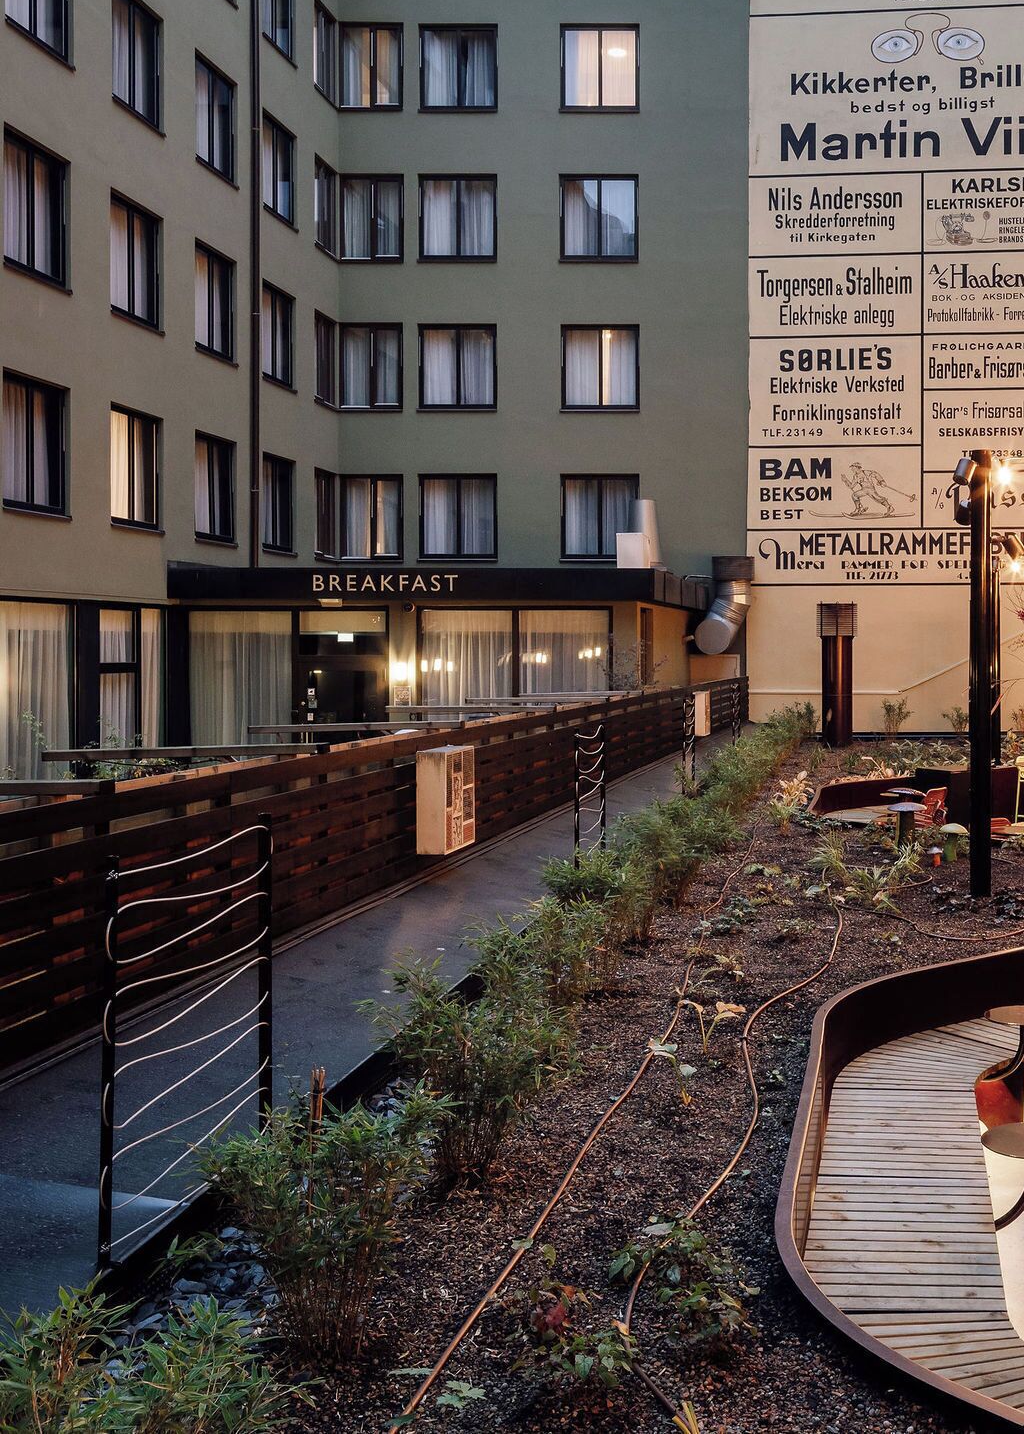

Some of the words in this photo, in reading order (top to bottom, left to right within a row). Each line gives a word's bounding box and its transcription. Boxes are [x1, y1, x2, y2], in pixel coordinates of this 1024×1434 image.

[791, 69, 936, 95] Kikkerter,
[851, 100, 905, 113] bedst
[913, 103, 930, 115] og
[939, 96, 995, 112] billigst
[781, 120, 940, 161] Martin
[769, 188, 802, 211] Nils
[810, 186, 902, 210] Andersson
[776, 212, 894, 230] Skredderforretning
[790, 233, 802, 242] til
[808, 232, 875, 244] Kirkegaten
[757, 270, 832, 303] Torgersen
[846, 267, 912, 295] Stalheim
[780, 304, 847, 325] Elektriske
[854, 304, 894, 327] anlegg
[929, 357, 975, 379] Barber
[771, 377, 837, 394] Elektriske
[845, 375, 904, 392] Verksted
[773, 403, 901, 424] Forniklingsanstalt
[760, 458, 831, 480] BAM
[760, 487, 831, 502] BEKSØM
[761, 509, 803, 520] BEST
[842, 561, 893, 569] RAMMER
[902, 560, 928, 569] FOR
[312, 574, 458, 592] BREAKFAST
